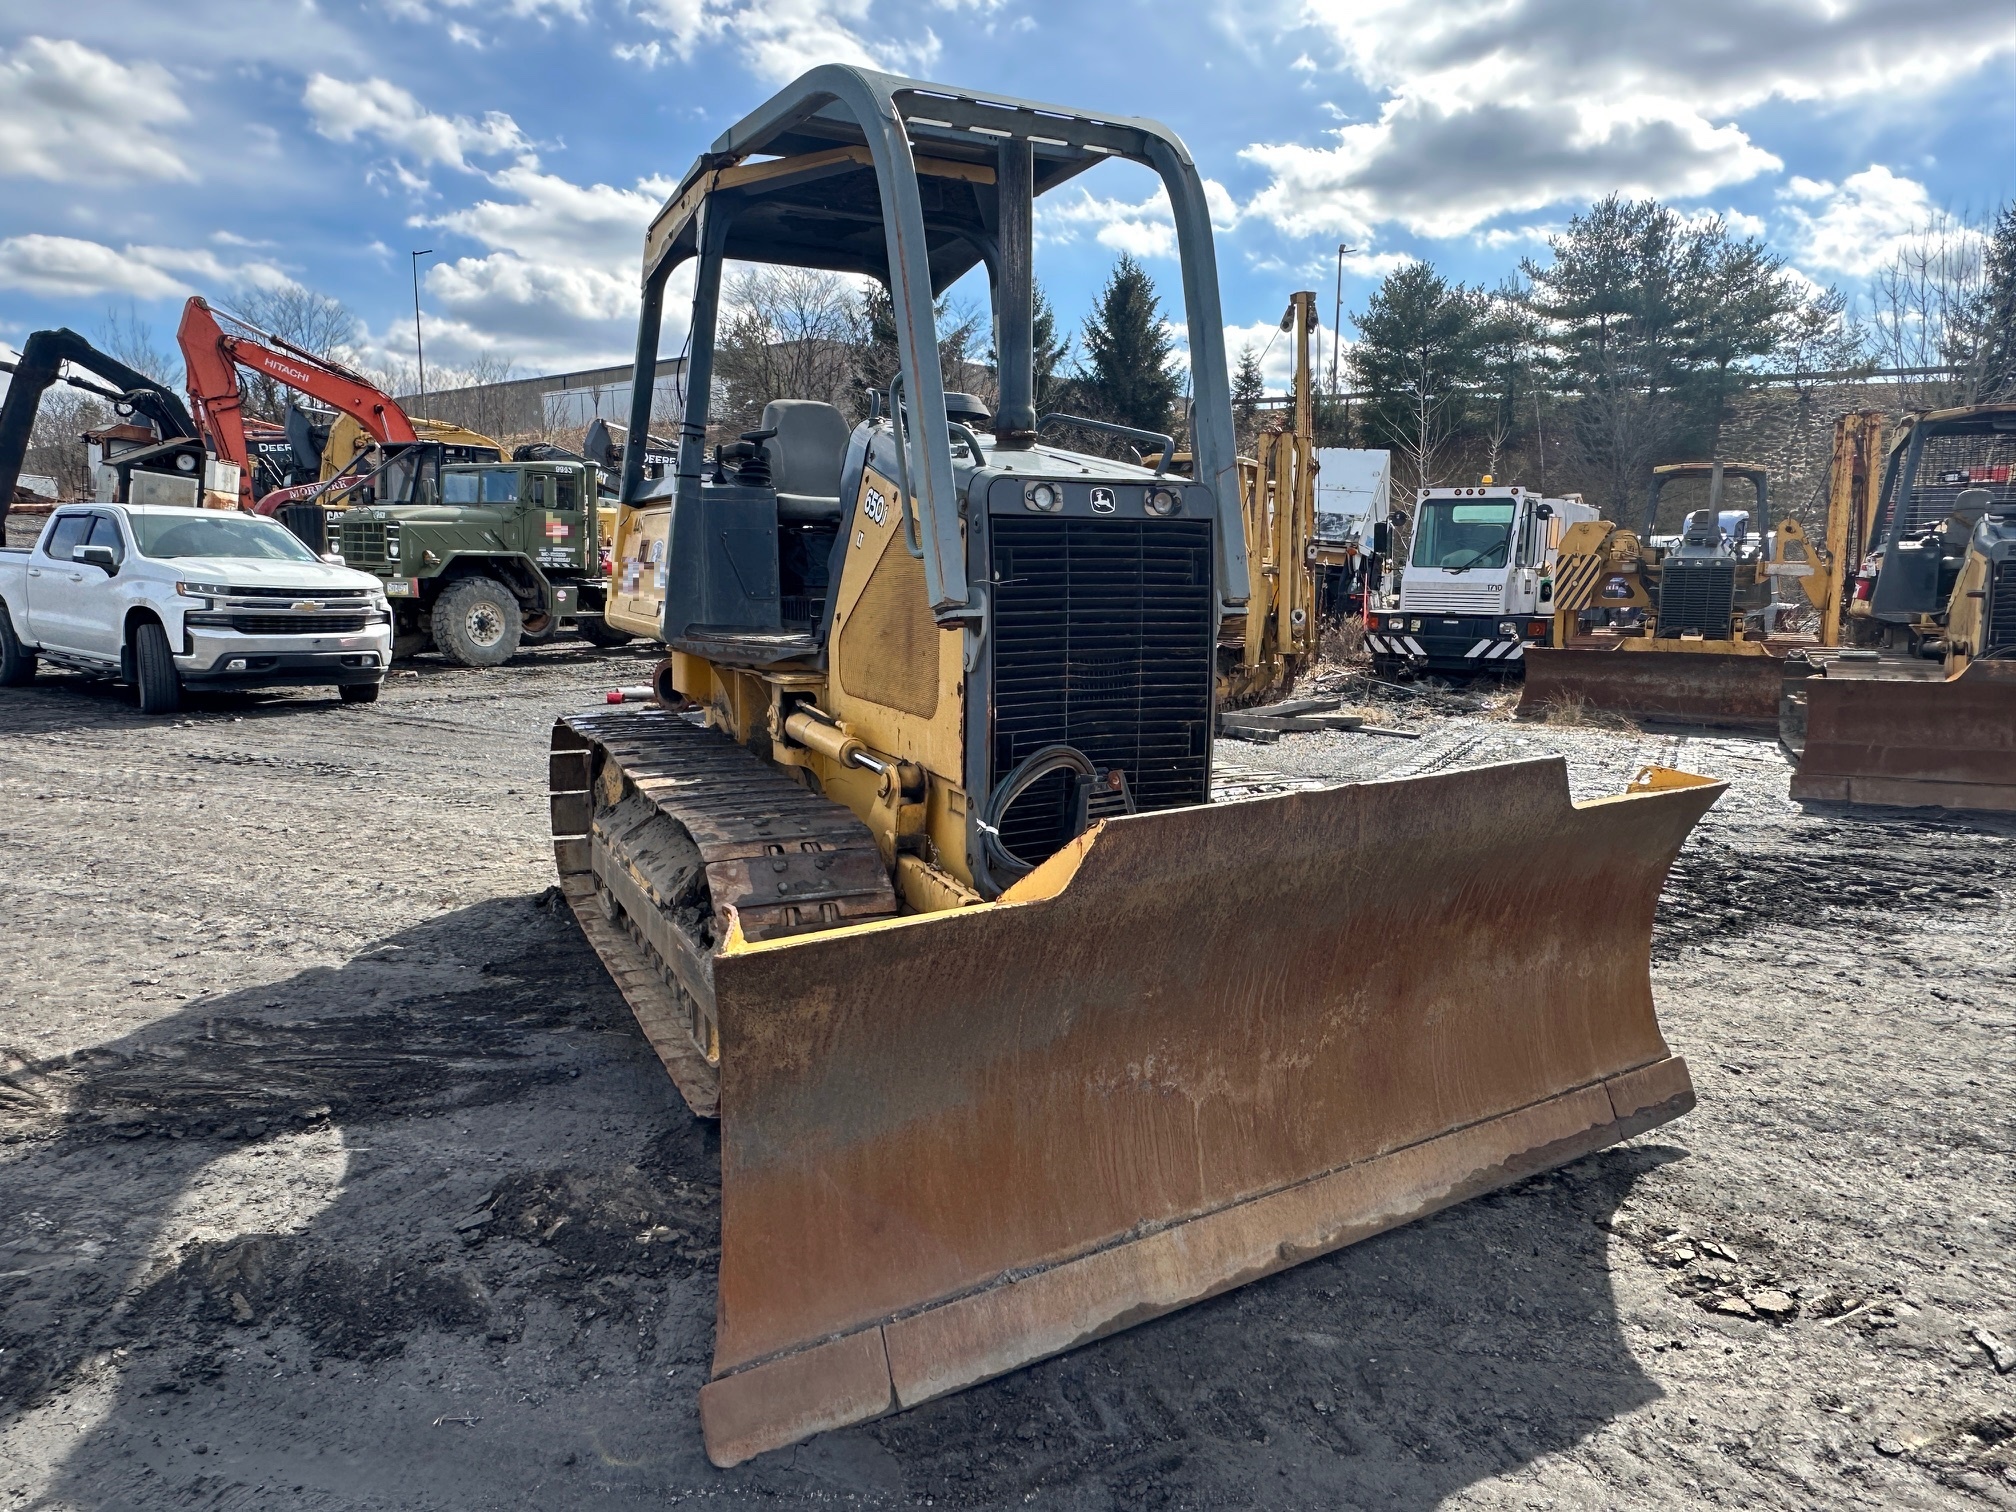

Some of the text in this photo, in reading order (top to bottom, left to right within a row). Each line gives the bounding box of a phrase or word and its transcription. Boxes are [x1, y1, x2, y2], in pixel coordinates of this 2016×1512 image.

[264, 357, 310, 382] HITACHI
[258, 443, 292, 453] DEER
[289, 479, 347, 499] MORRK
